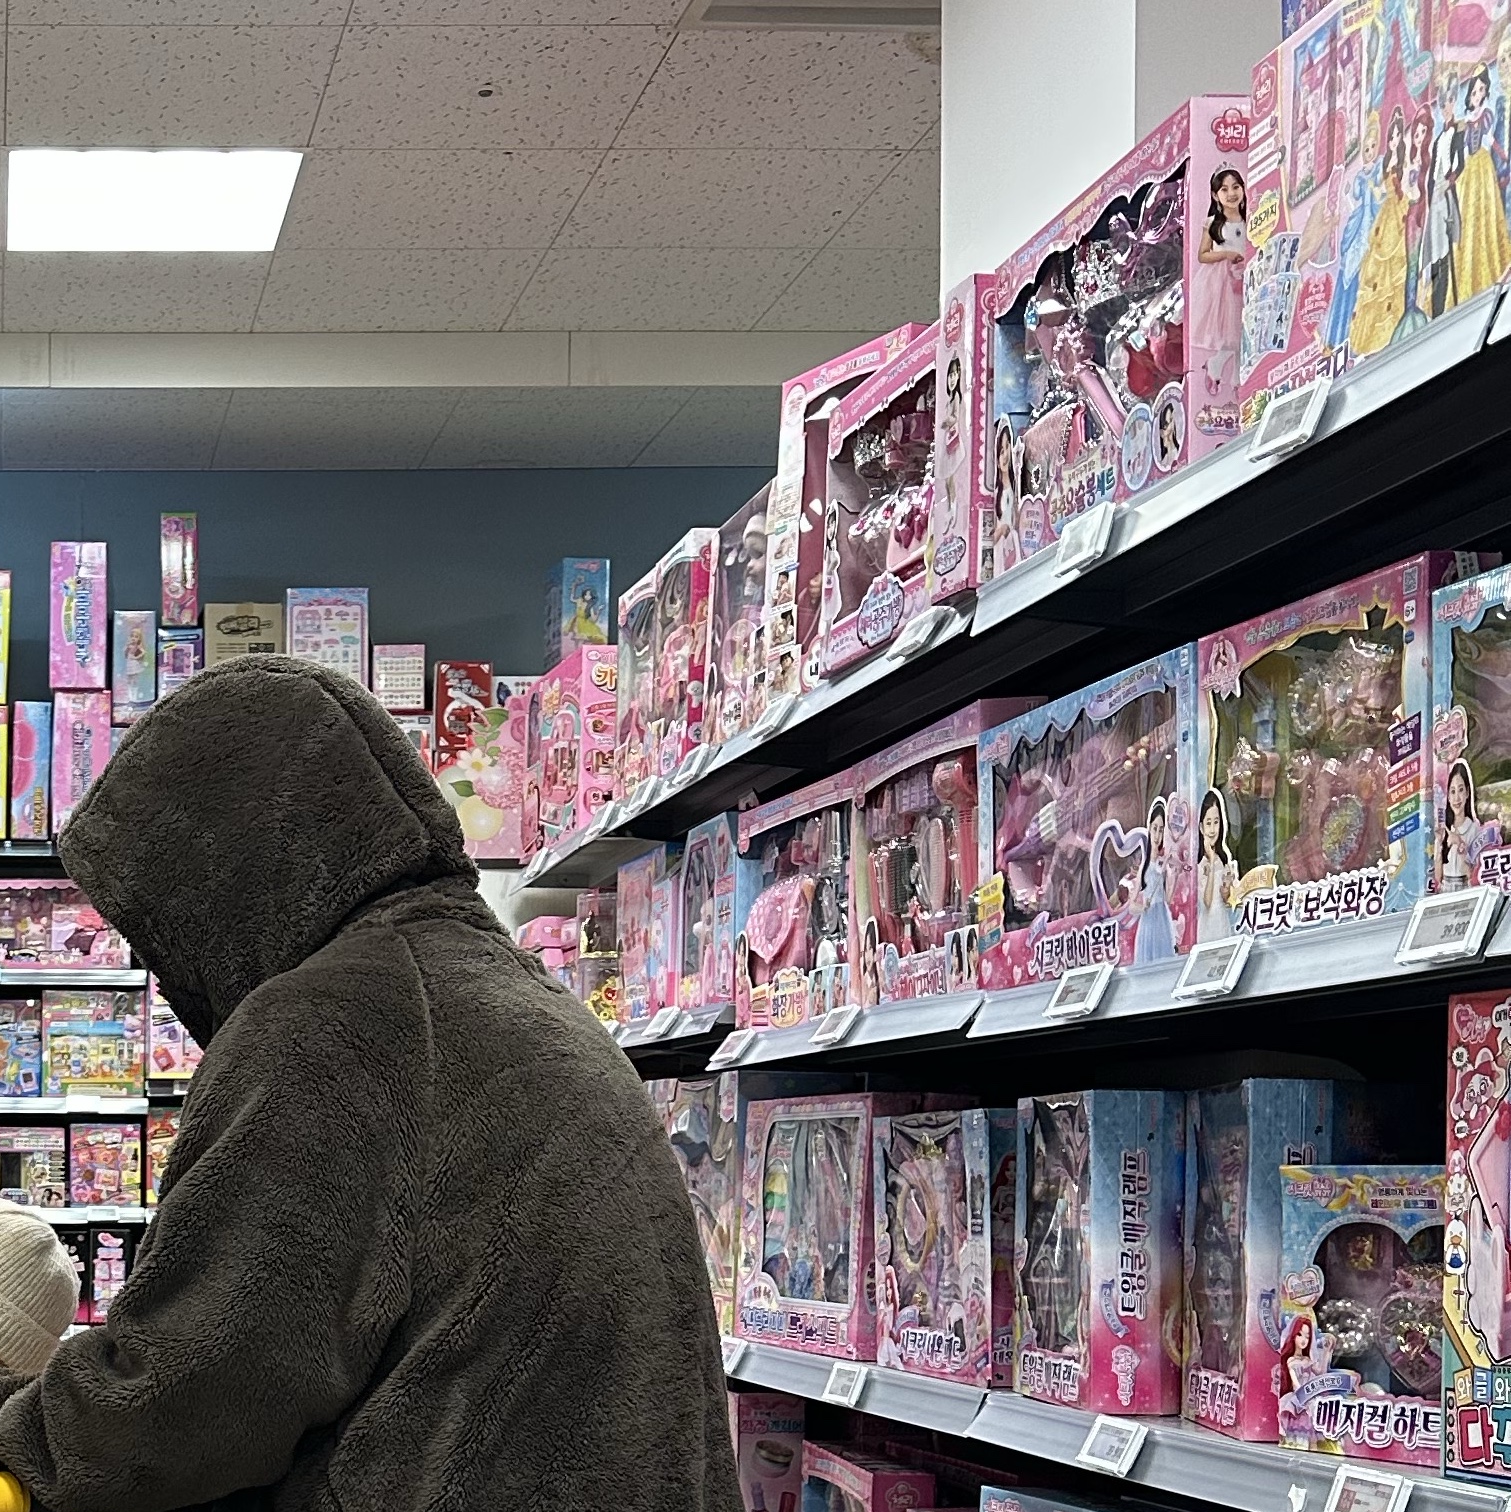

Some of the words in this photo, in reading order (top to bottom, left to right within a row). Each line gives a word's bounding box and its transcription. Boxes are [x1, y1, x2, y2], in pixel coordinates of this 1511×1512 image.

[1237, 889, 1297, 937] 시크릿
[1301, 874, 1390, 928] 보석화장
[1030, 936, 1066, 977] 시크릿
[1065, 918, 1120, 968] 바이올린
[1314, 1398, 1389, 1449] 매지컬
